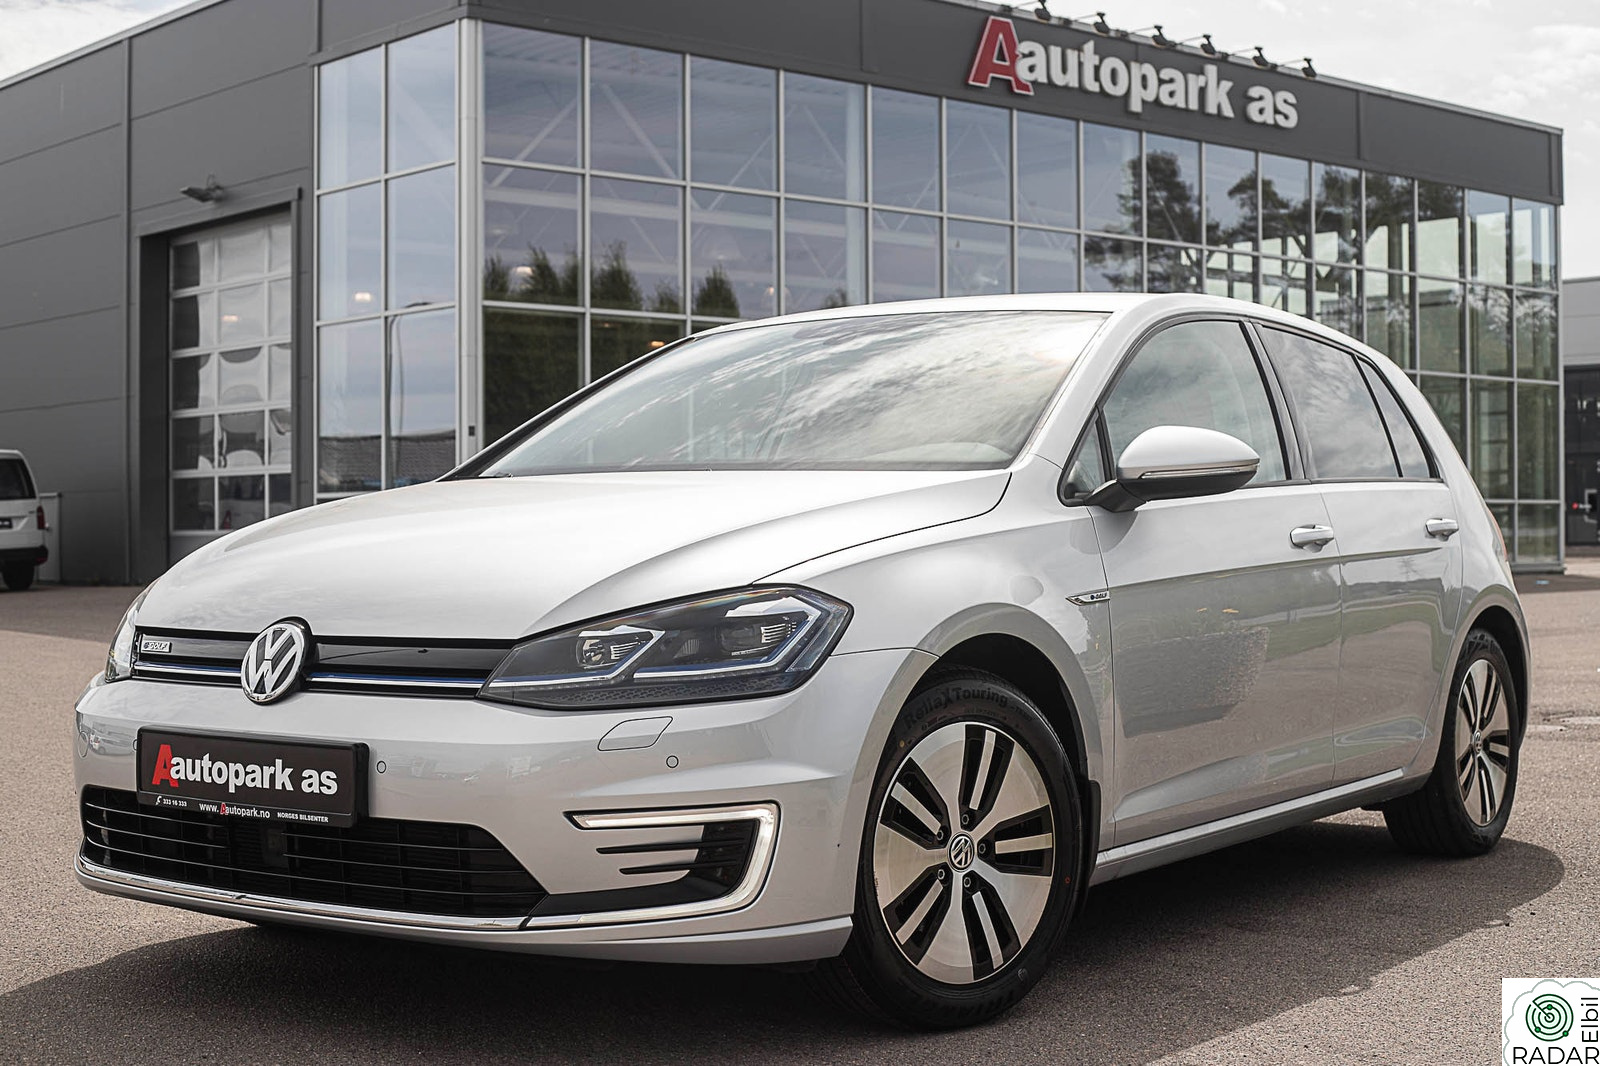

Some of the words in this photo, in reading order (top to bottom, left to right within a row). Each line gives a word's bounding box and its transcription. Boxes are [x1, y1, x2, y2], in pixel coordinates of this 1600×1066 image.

[1246, 85, 1298, 129] as
[301, 768, 338, 795] as
[277, 811, 299, 820] NORGES
[299, 814, 329, 823] BILSENTER
